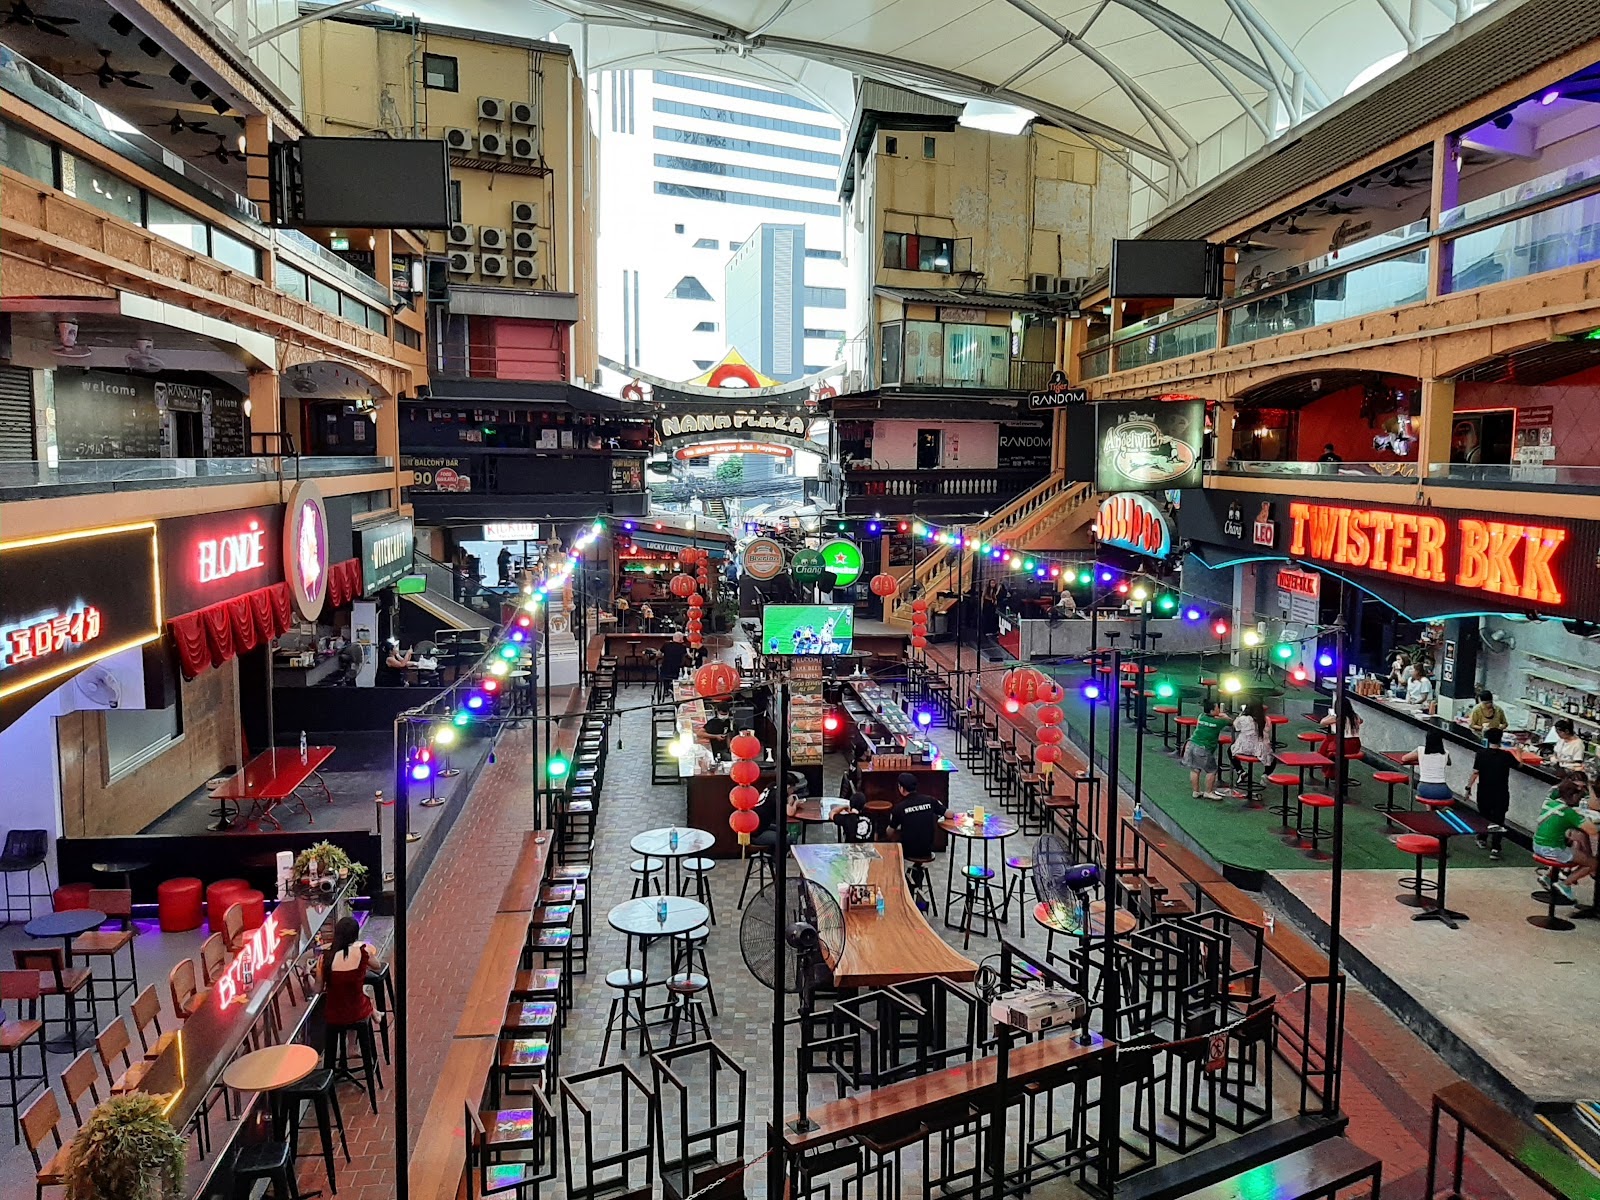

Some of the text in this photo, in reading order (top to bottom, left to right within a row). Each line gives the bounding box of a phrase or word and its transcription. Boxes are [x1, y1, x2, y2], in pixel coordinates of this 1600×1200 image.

[81, 380, 136, 397] welcome
[1050, 383, 1066, 393] Tiger
[1032, 392, 1085, 406] RANDOM
[661, 409, 805, 437] NANA PLAZA
[1000, 436, 1051, 447] RANDOM
[1104, 426, 1164, 458] Angelwitch
[414, 459, 444, 467] BALCONY
[445, 459, 459, 467] BAR
[414, 471, 432, 485] 90
[1097, 497, 1162, 554] LOLLIPOP
[1224, 520, 1242, 539] Chang
[1255, 524, 1273, 545] LEO
[198, 521, 265, 583] BLONDIE
[647, 542, 665, 550] LUCKY
[1289, 502, 1566, 605] TWISTER BKK
[796, 565, 822, 575] Chang
[904, 803, 931, 814] SECURITY
